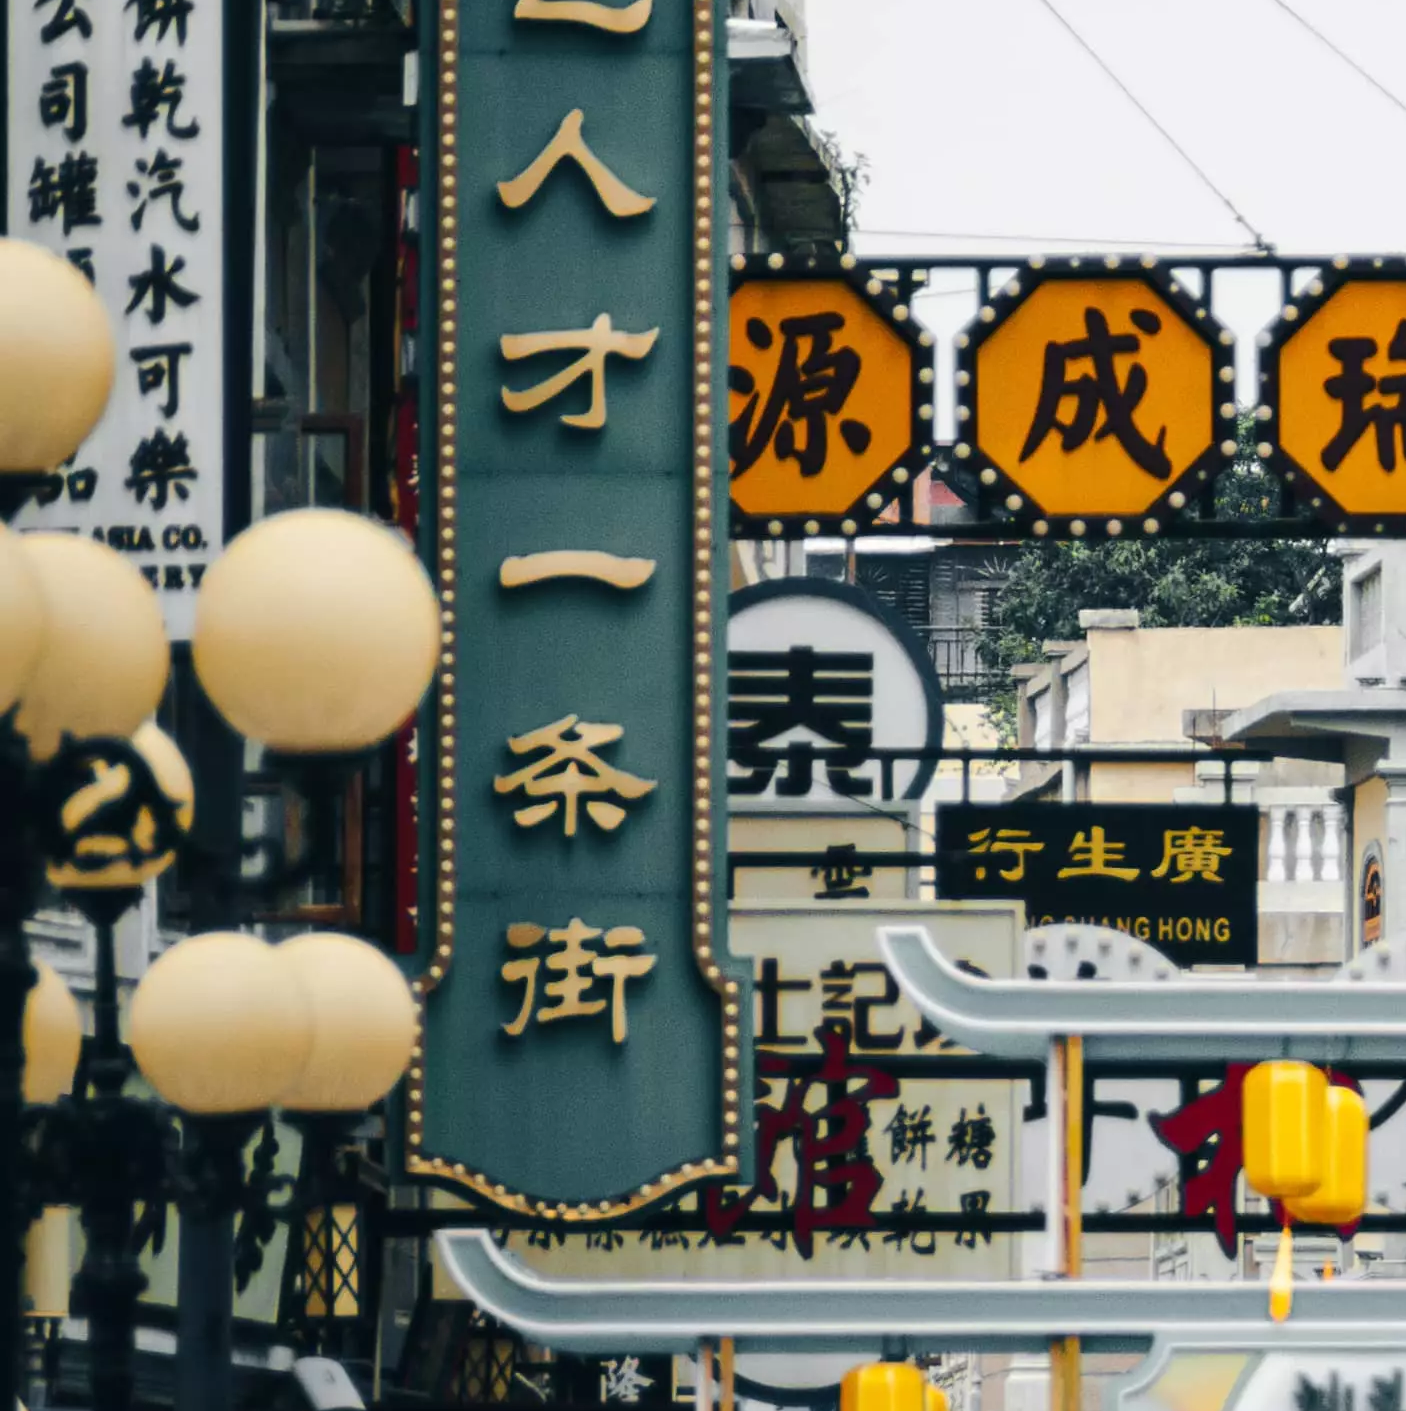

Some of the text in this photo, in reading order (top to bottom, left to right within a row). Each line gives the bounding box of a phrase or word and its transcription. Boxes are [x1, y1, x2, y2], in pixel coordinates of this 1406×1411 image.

[966, 825, 1233, 884] 廣生行
[1157, 916, 1232, 942] HONG
